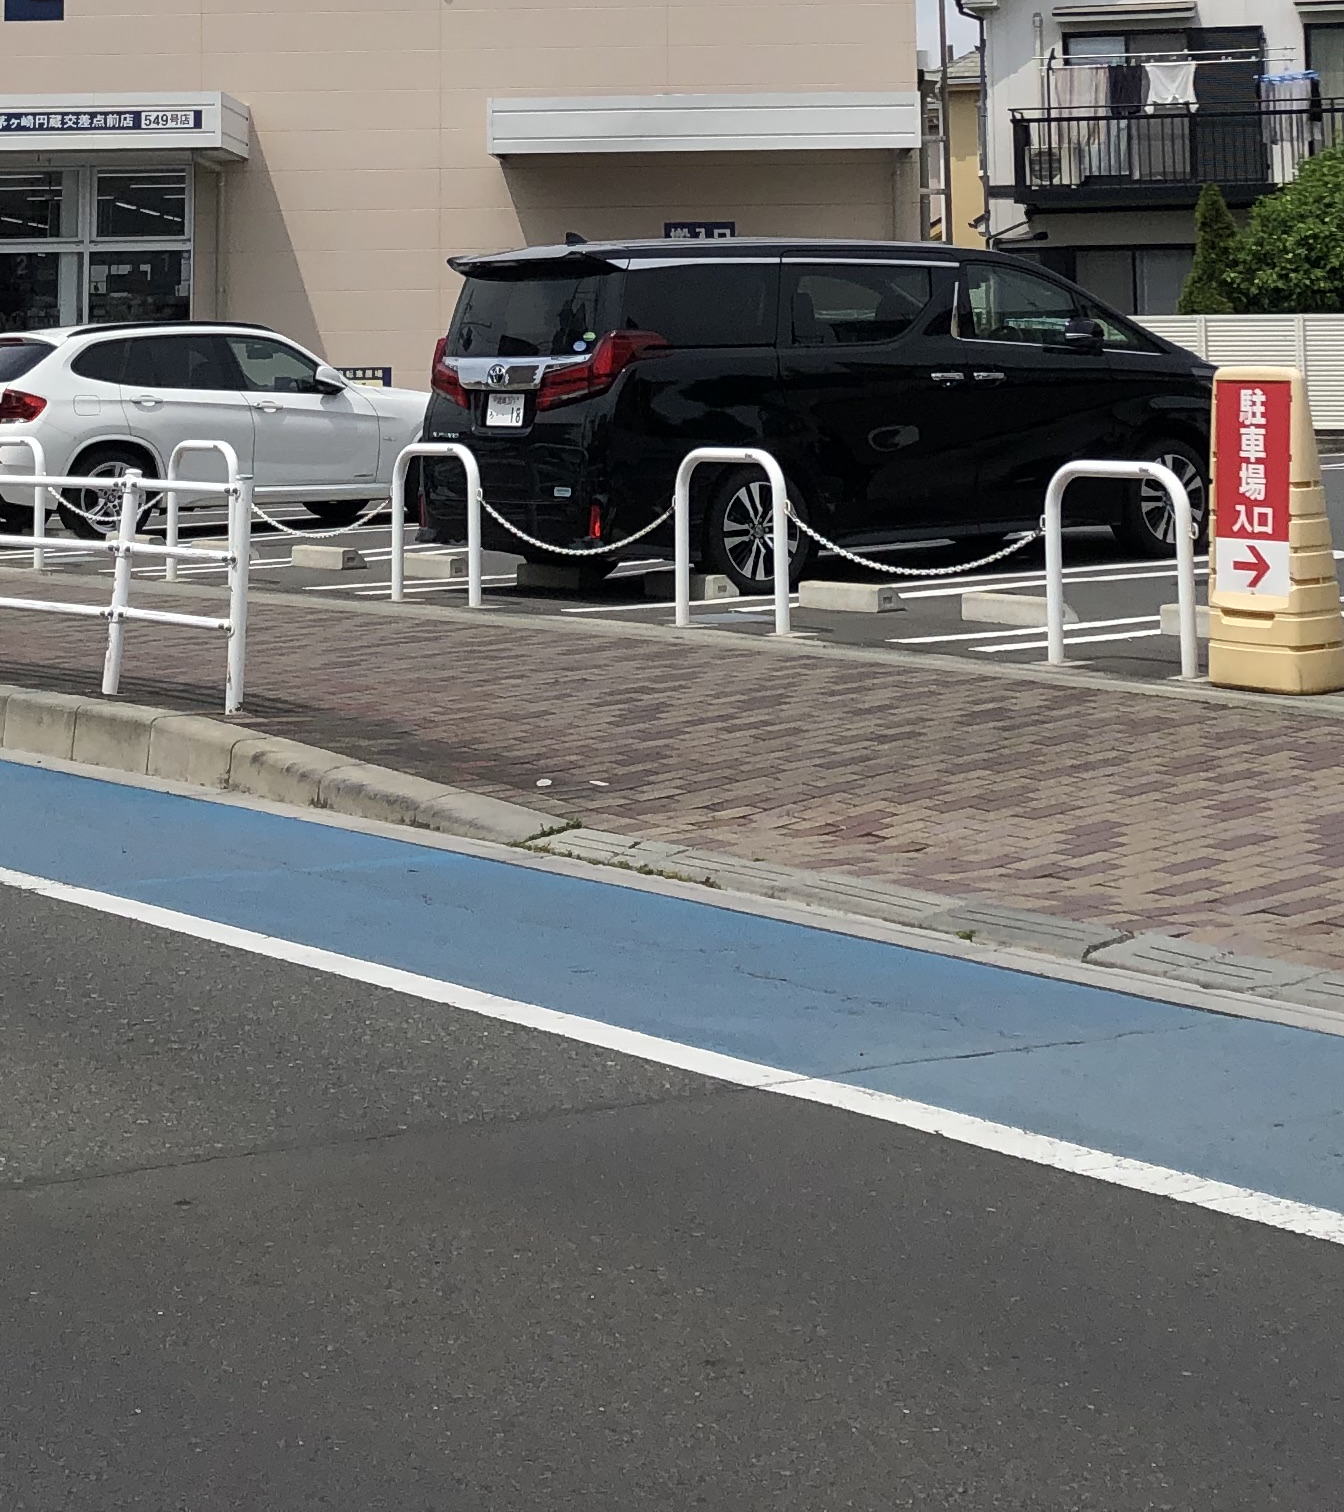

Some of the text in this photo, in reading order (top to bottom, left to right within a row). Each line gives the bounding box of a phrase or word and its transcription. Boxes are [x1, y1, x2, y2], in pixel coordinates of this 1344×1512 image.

[143, 113, 191, 127] 549号店
[1238, 388, 1267, 501] 駐車場
[1232, 504, 1273, 535] 入口
